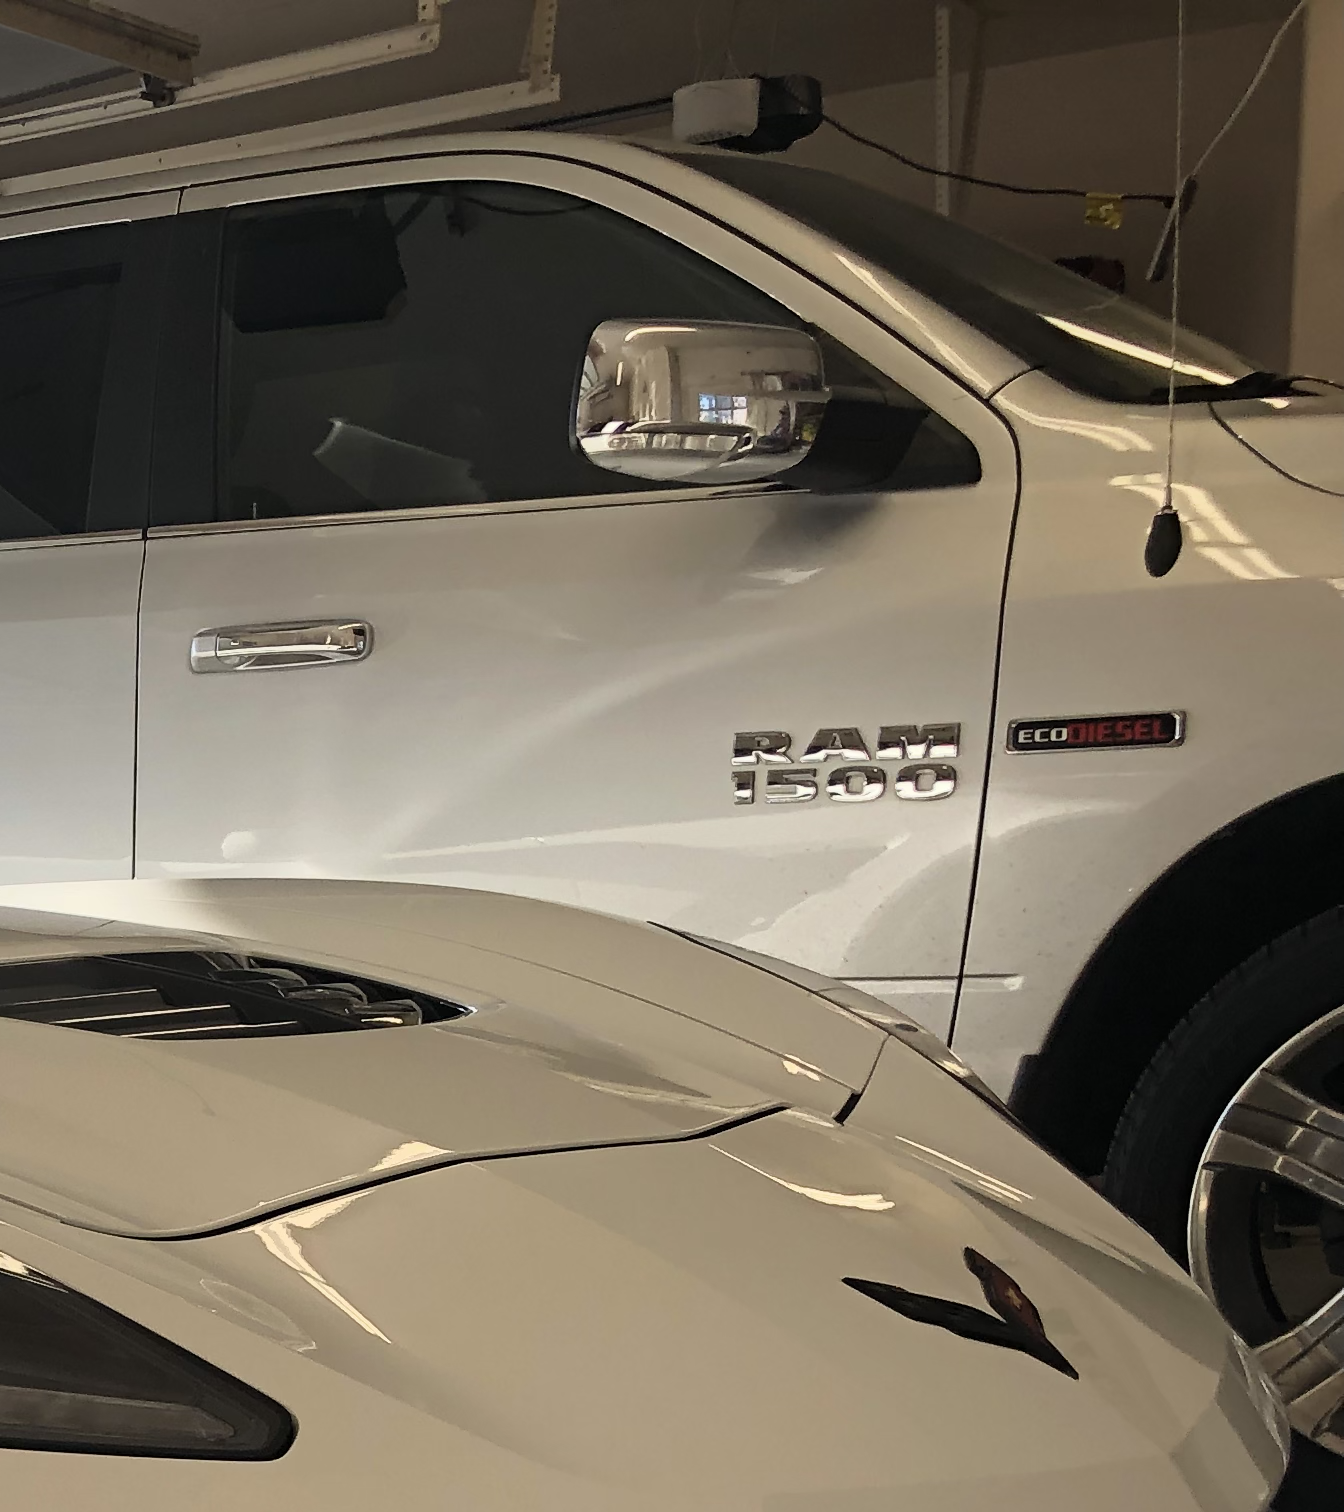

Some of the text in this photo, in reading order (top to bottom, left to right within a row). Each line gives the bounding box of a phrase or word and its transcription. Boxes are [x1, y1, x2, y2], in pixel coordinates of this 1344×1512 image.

[730, 722, 962, 766] RAM
[1018, 718, 1169, 745] ECODIESEL
[730, 763, 959, 805] 1500
